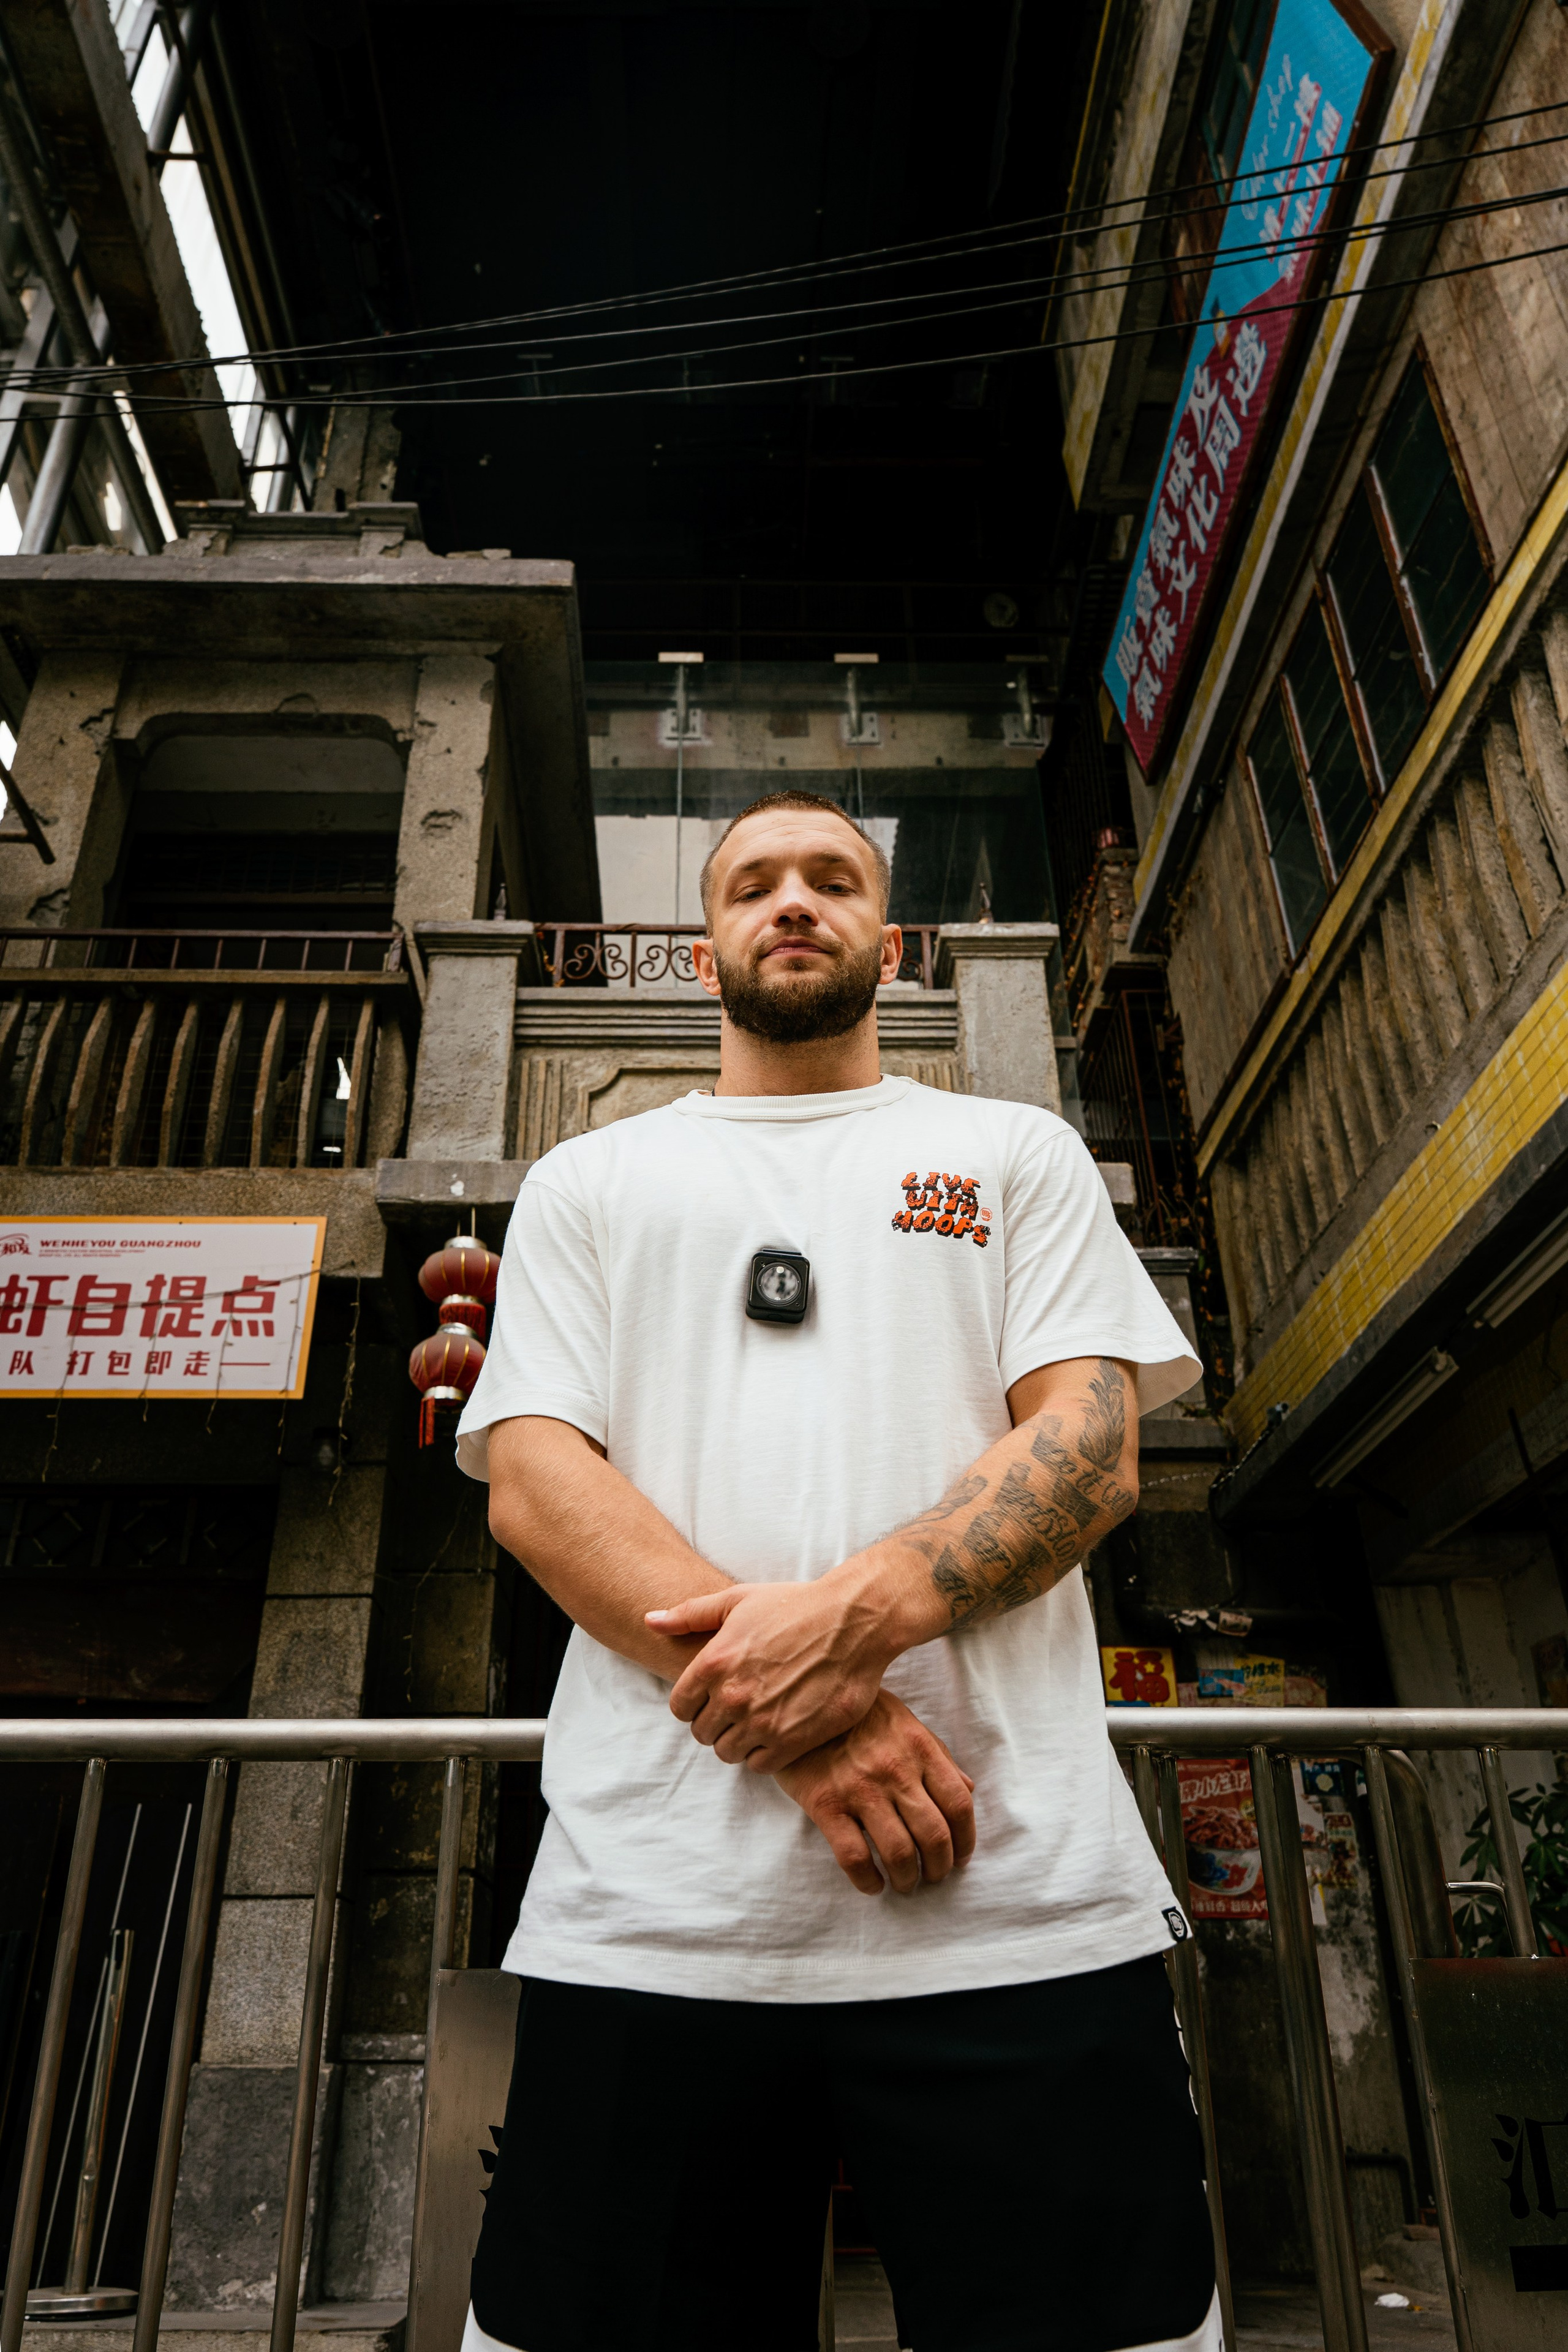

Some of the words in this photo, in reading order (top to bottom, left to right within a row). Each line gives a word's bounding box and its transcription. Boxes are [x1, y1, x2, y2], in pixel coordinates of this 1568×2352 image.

[901, 1172, 981, 1200] LIVE
[119, 1240, 201, 1248] GUANGZHOU
[0, 1274, 281, 1337] 虾自提点
[67, 1351, 210, 1376] 打包即走
[1109, 1651, 1170, 1703] 福
